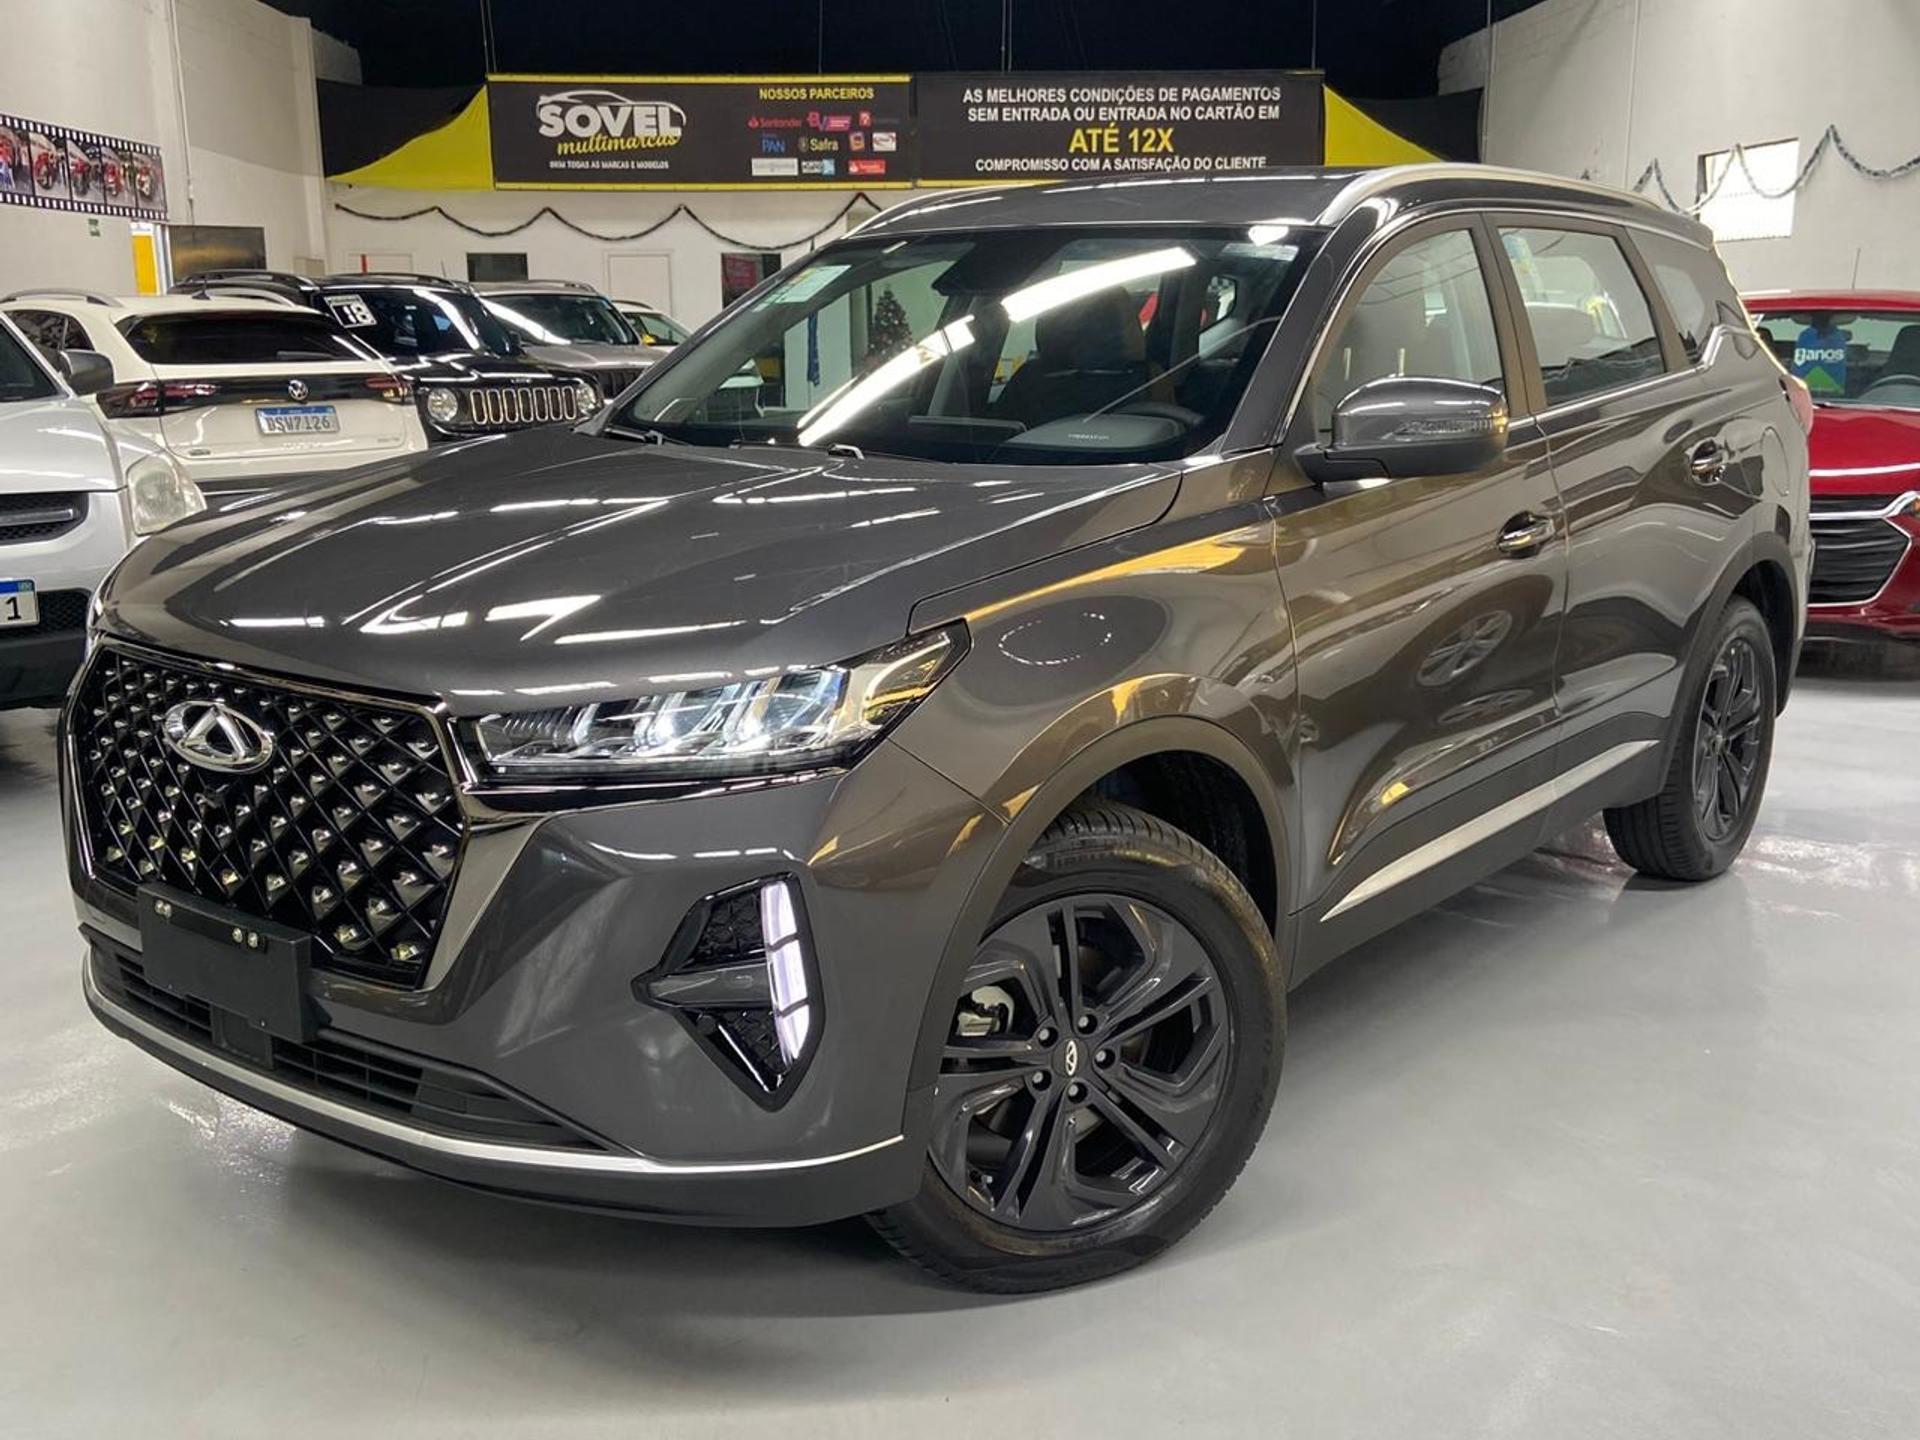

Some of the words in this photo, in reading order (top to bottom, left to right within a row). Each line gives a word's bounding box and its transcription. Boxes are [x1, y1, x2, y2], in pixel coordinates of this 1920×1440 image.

[759, 88, 807, 100] NOSSOS
[809, 87, 874, 99] PARCEIROS
[963, 88, 983, 103] AS
[986, 88, 1066, 103] MELHORES
[1069, 85, 1154, 105] CONDIÇÕES
[1158, 88, 1178, 102] DE
[1182, 87, 1281, 102] PAGAMENTOS
[538, 104, 682, 138] SOVEL
[968, 107, 998, 121] SEM
[1002, 107, 1071, 121] ENTRADA
[1073, 106, 1095, 121] OU
[1099, 106, 1167, 121] ENTRADA
[1170, 106, 1191, 120] NO
[1195, 103, 1254, 120] CARTÃO
[1258, 105, 1280, 120] EM
[557, 134, 681, 156] multimarcas
[1069, 122, 1120, 153] ATÉ
[1128, 127, 1174, 153] 12X
[975, 158, 1069, 171] COMPROMISSO
[1071, 158, 1099, 171] COM
[1102, 158, 1112, 171] A
[1114, 155, 1191, 172] SATISFAÇÃO
[1193, 157, 1212, 170] DO
[1214, 156, 1267, 169] CLIENTE
[6, 597, 21, 620] 1
